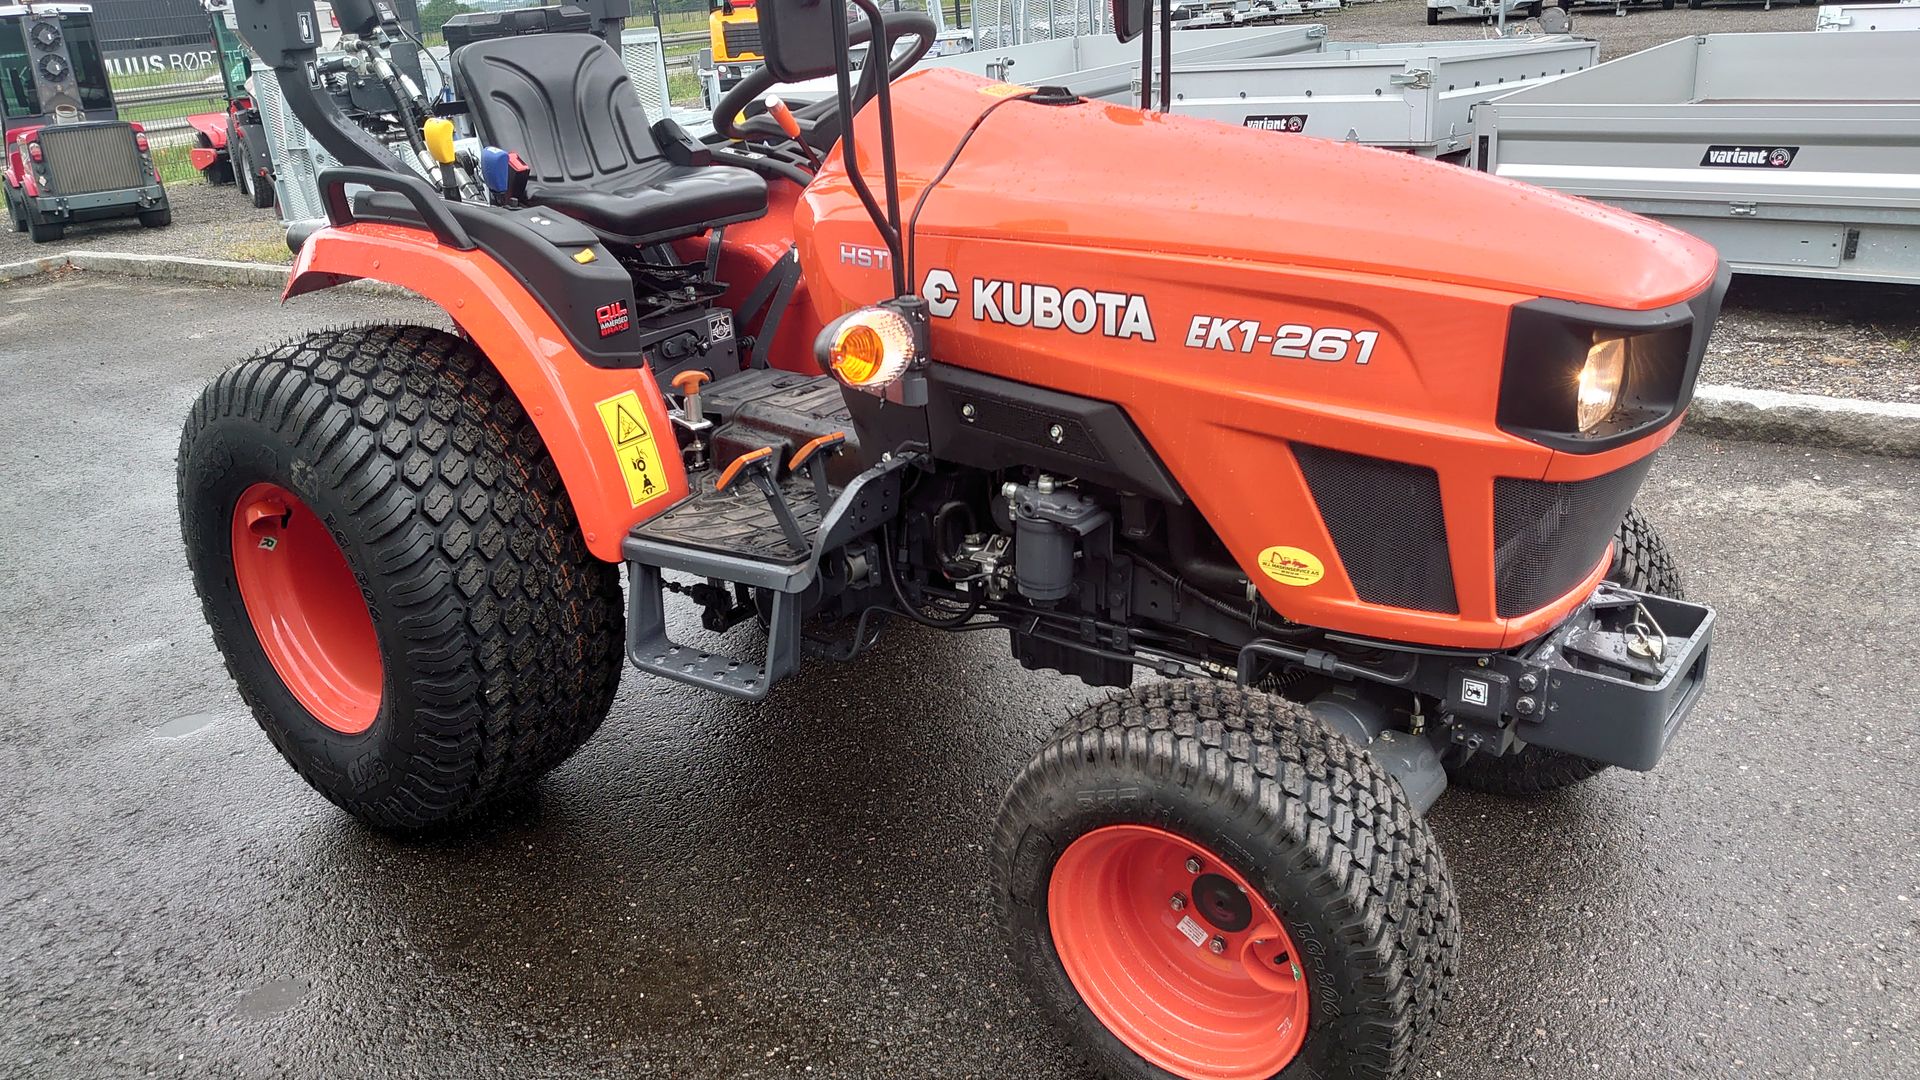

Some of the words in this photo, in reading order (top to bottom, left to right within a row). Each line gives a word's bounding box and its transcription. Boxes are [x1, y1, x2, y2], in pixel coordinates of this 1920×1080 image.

[1247, 117, 1287, 130] variant
[1709, 147, 1768, 164] variant
[840, 244, 889, 269] HST
[596, 302, 628, 322] OIL
[973, 277, 1156, 342] KUBOTA
[1185, 315, 1380, 364] EK1-261
